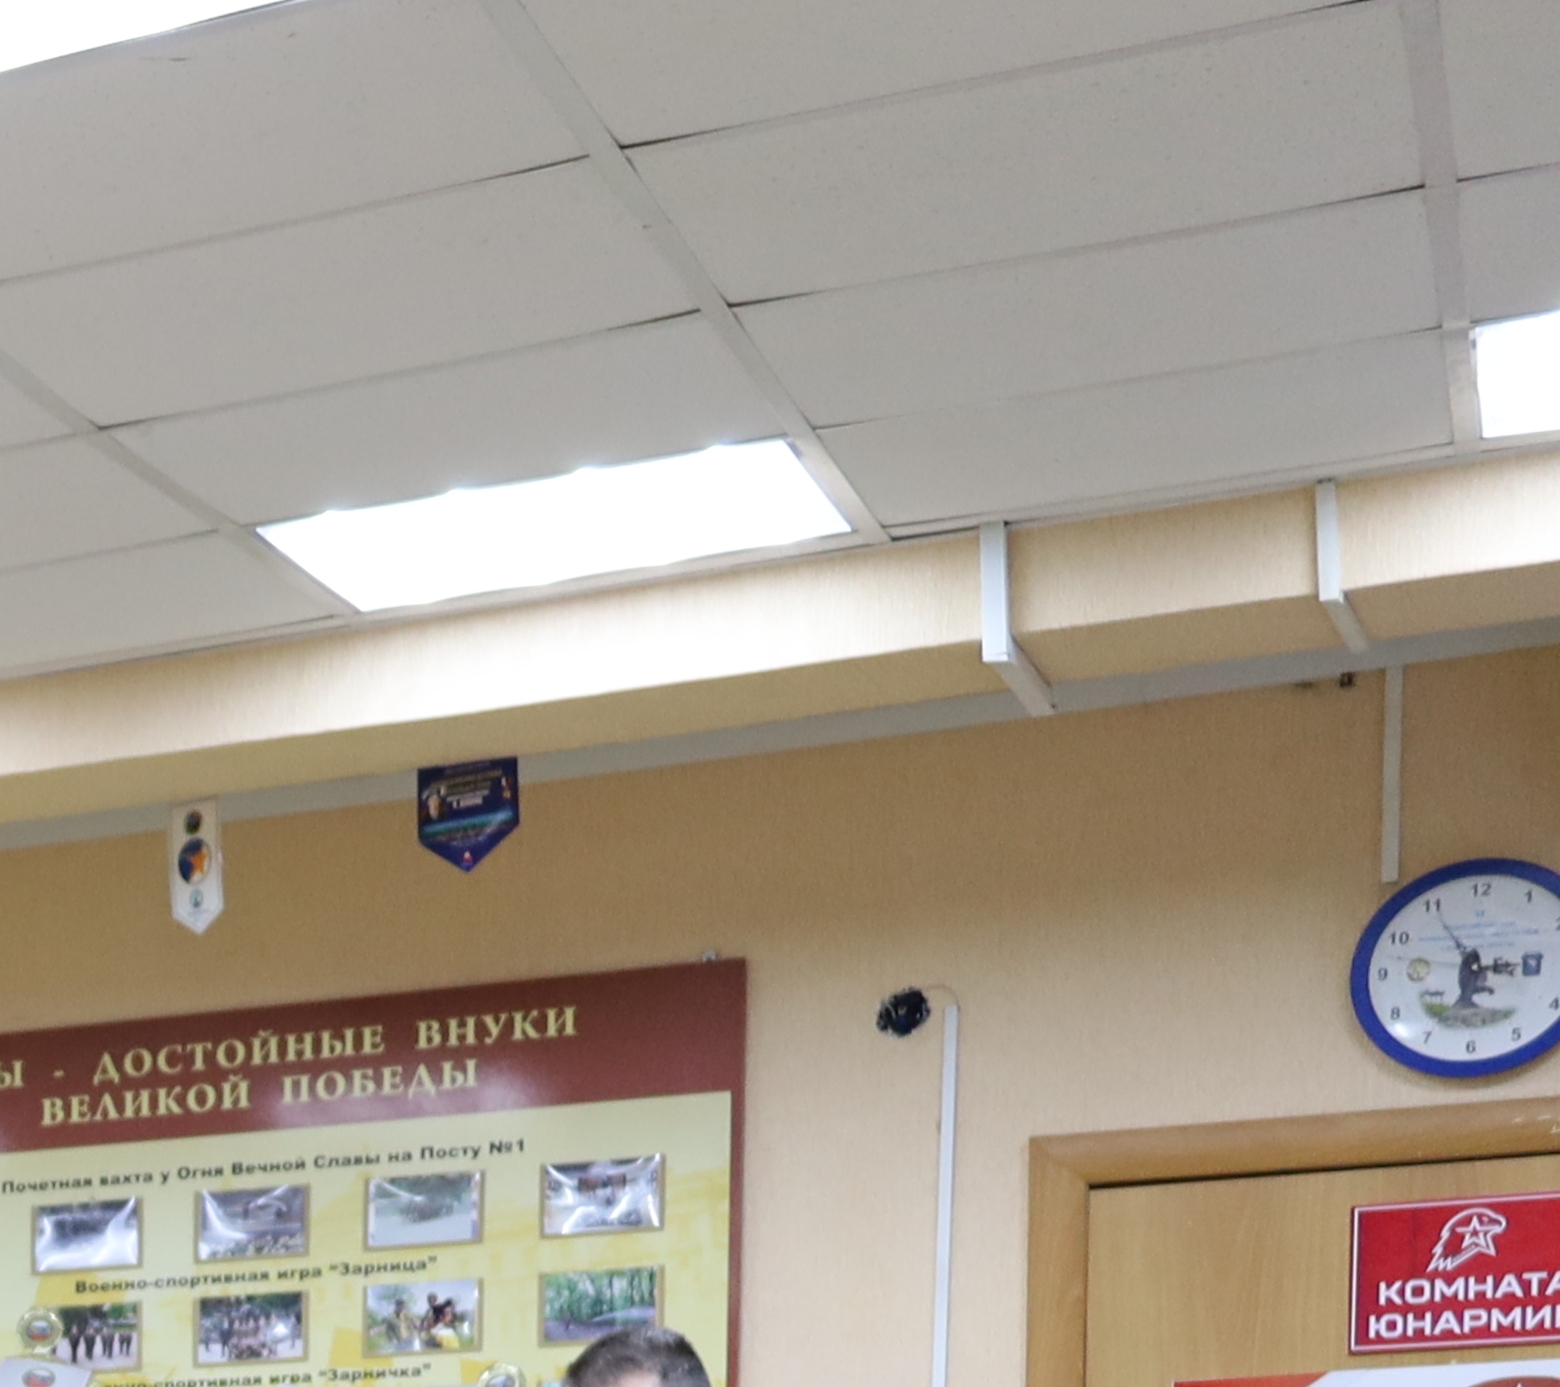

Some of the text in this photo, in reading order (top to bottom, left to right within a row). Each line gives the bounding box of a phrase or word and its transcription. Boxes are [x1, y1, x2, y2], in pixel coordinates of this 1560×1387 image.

[1472, 883, 1492, 896] 12
[1525, 890, 1532, 902] 1
[1423, 899, 1441, 912] 11
[1390, 932, 1409, 945] 10
[1378, 968, 1388, 981] 9
[1390, 1007, 1400, 1020] 8
[1423, 1032, 1432, 1044] 7
[1512, 1028, 1521, 1040] 5
[93, 1025, 385, 1086] ДОСТОЙНЫЕ
[415, 1006, 577, 1050] ВНУКИ
[1466, 1041, 1476, 1054] 6
[41, 1059, 477, 1126] ВЕЛИКОЙ ПОБЕДЫ
[1, 1179, 93, 1193] Почетная
[100, 1172, 153, 1186] вахта
[160, 1171, 170, 1184] у
[177, 1166, 224, 1180] Огня
[232, 1158, 306, 1176] Вечной
[313, 1154, 381, 1169] Славы
[388, 1152, 412, 1164] на
[420, 1145, 481, 1160] Посту
[75, 1269, 270, 1294] Военно-спортивная
[277, 1266, 321, 1282] игра
[1368, 1304, 1560, 1338] ЮНАРМИ
[269, 1373, 312, 1387] игра
